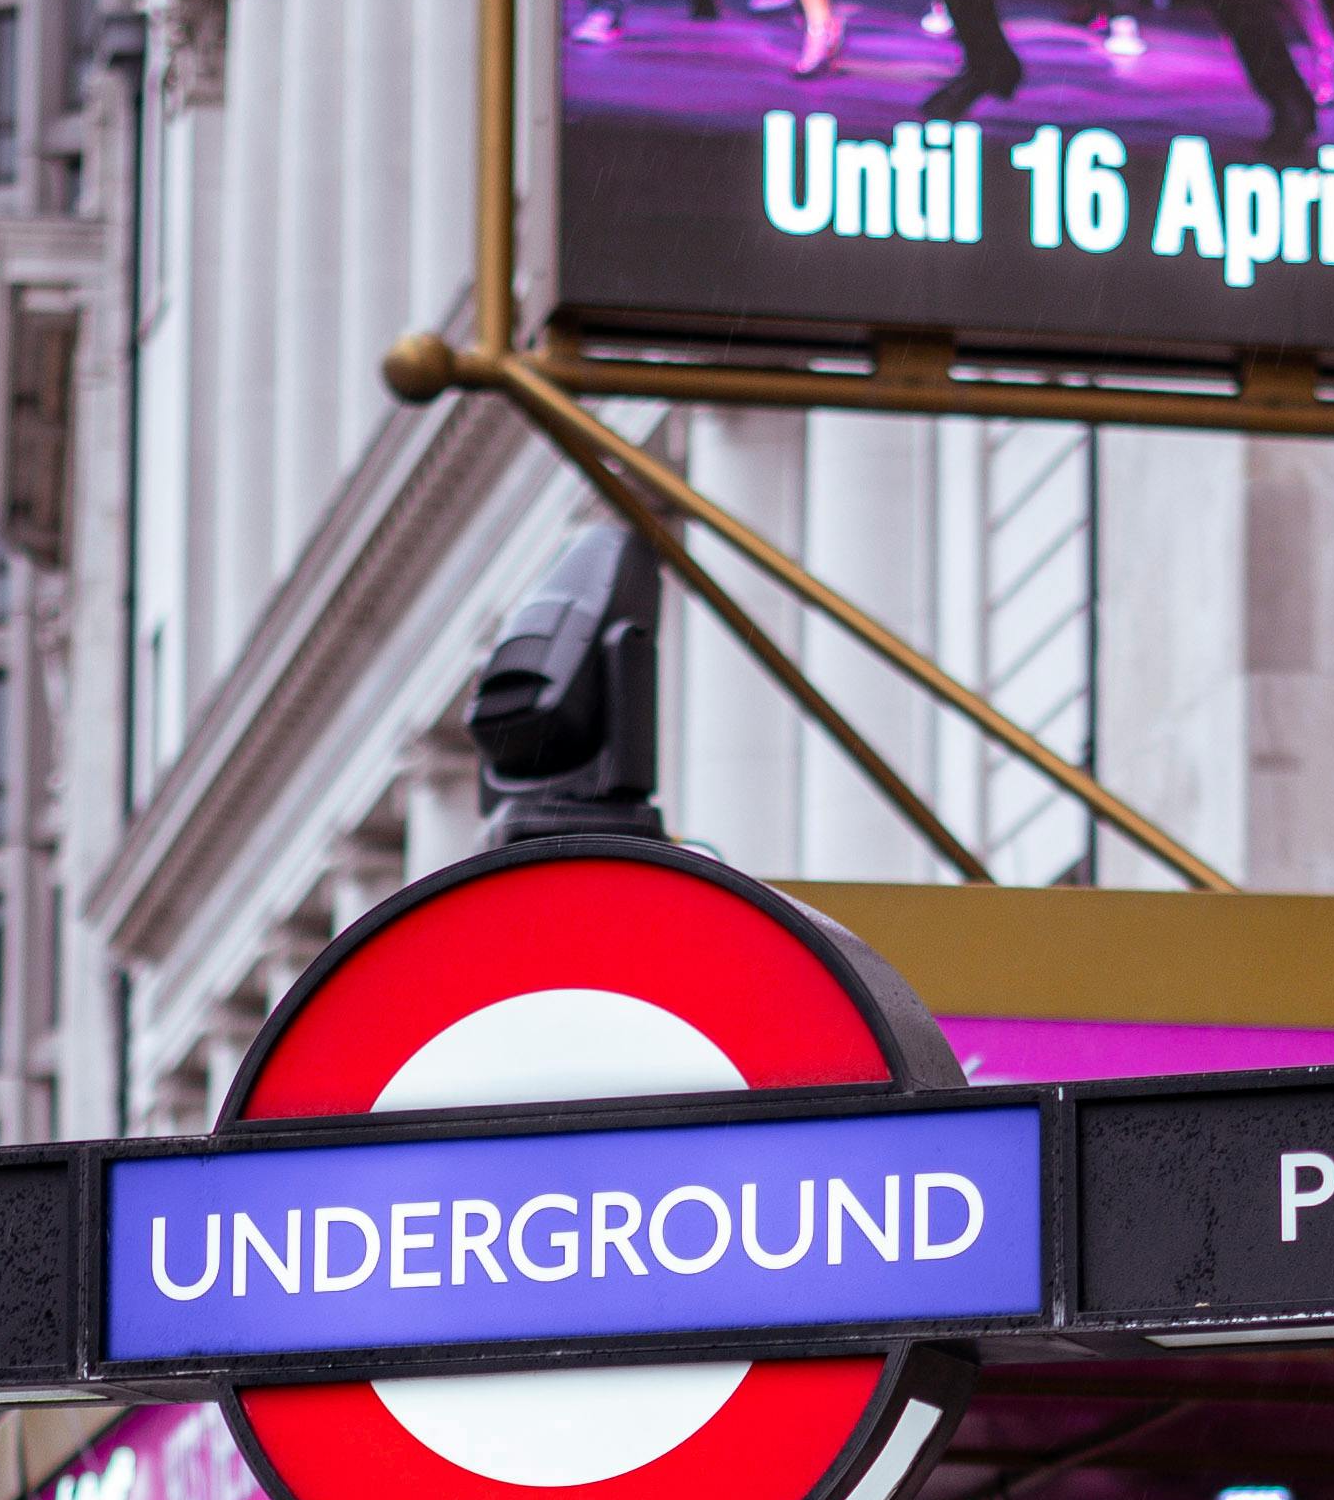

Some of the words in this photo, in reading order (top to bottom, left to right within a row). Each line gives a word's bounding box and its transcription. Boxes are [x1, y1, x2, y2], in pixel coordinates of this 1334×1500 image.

[762, 110, 983, 243] Until
[1009, 123, 1129, 255] 16
[150, 1171, 986, 1303] UNDERGROUND
